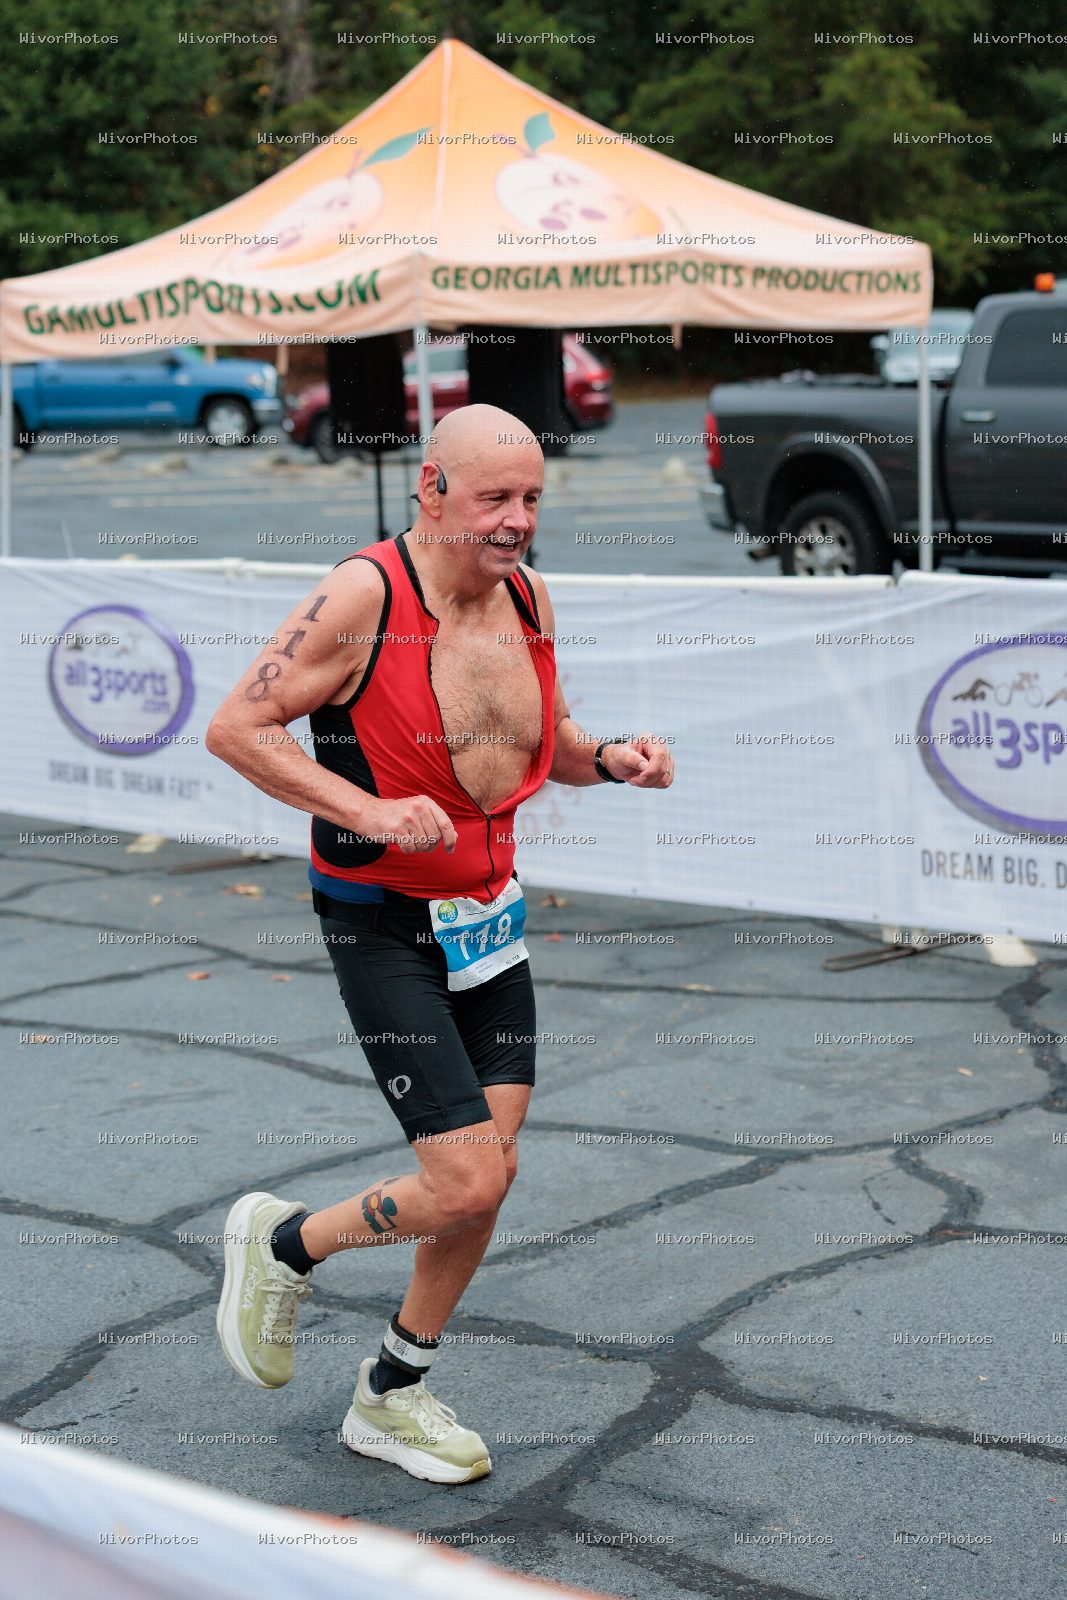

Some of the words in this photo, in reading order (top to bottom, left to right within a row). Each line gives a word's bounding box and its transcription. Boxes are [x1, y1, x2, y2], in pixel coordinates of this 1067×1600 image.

[431, 265, 562, 290] GEORGIA
[570, 260, 744, 288] MULTISPORTS
[752, 266, 922, 293] PRODUCTIONS
[921, 849, 994, 882] DREAM
[1003, 856, 1046, 888] BIG.
[459, 912, 512, 961] 118
